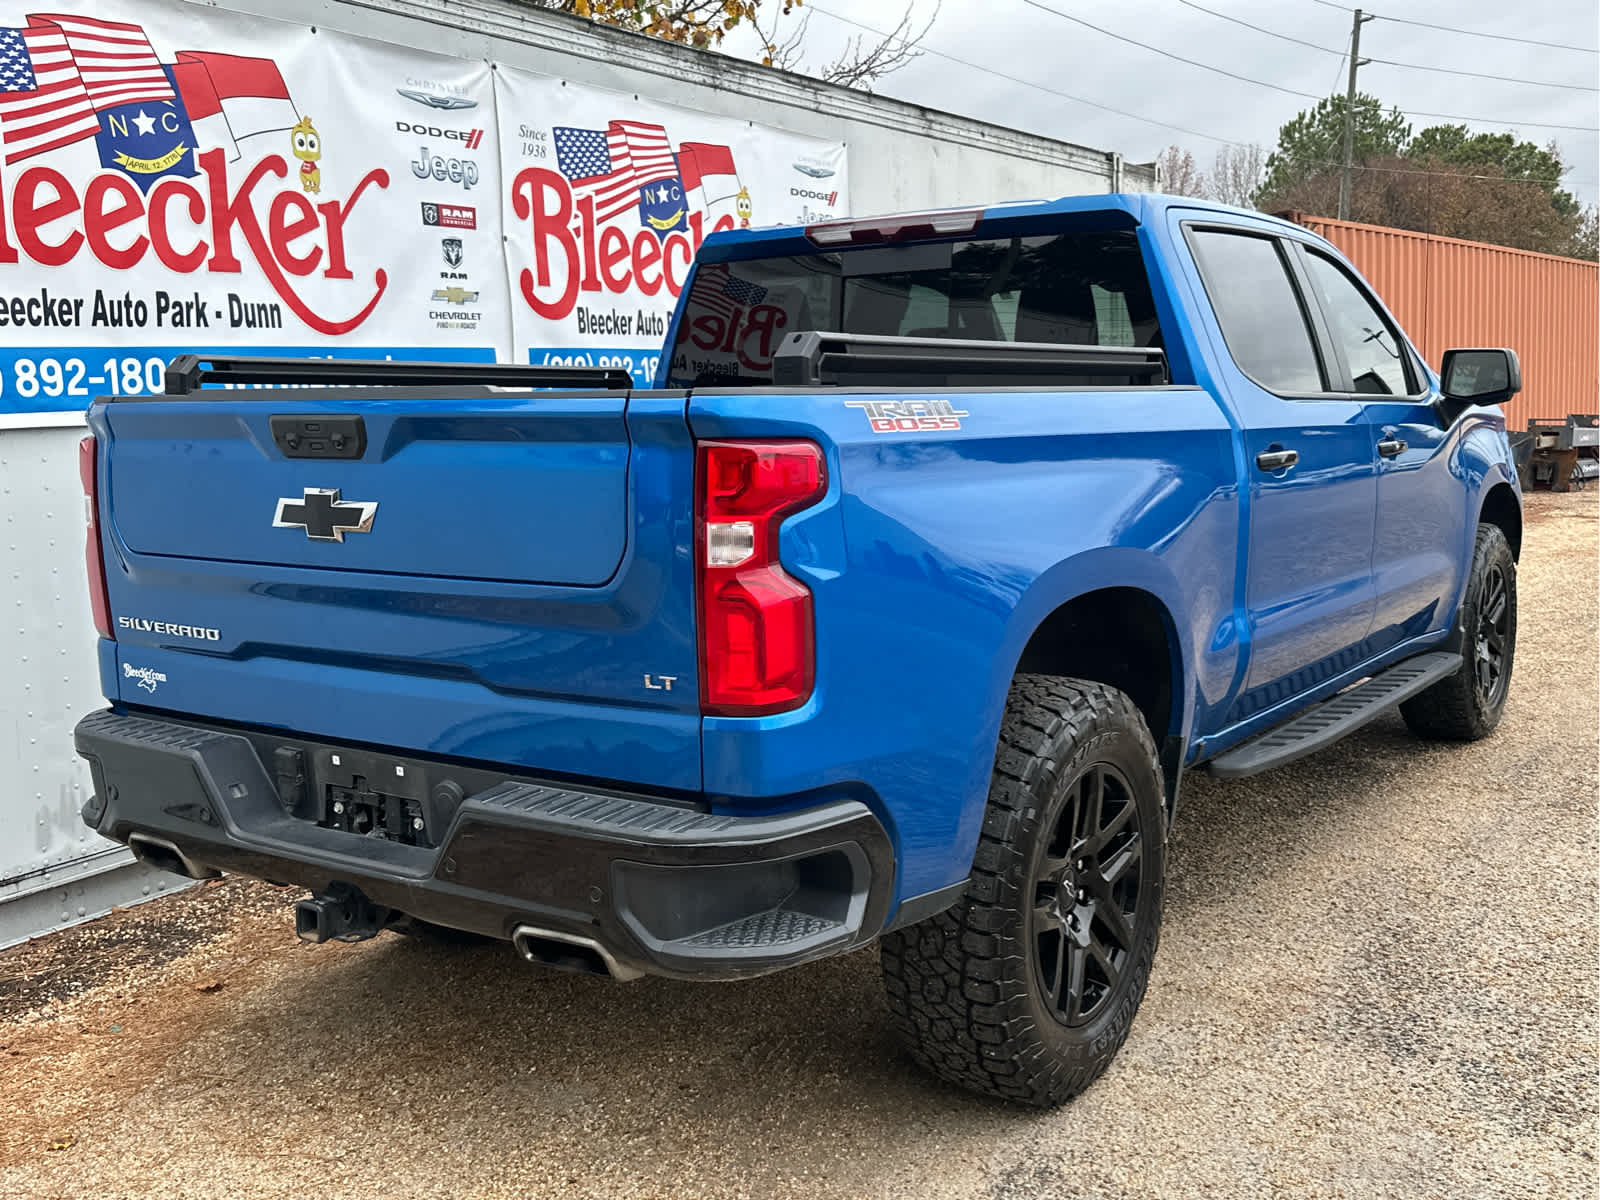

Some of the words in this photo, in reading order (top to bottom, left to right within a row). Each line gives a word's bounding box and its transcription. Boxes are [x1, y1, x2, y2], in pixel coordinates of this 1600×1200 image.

[108, 113, 128, 138] N
[160, 111, 180, 134] C
[395, 121, 473, 142] DODGE
[518, 124, 547, 142] Since
[521, 141, 547, 159] 1938
[127, 160, 151, 169] APRIL
[411, 146, 479, 190] Jeep
[790, 187, 832, 202] DODGE
[441, 208, 474, 219] RAM
[440, 271, 468, 280] RAM
[92, 289, 148, 328] Auto
[156, 290, 210, 329] Park
[228, 293, 283, 329] Dunn
[428, 310, 482, 321] CHEVROLET
[577, 306, 633, 337] Bleecker
[636, 307, 663, 337] Auto
[13, 356, 176, 398] 892-180
[843, 399, 970, 418] TRAIL
[870, 416, 961, 433] BOSS
[118, 615, 221, 641] SILVERADO
[643, 673, 678, 691] LT
